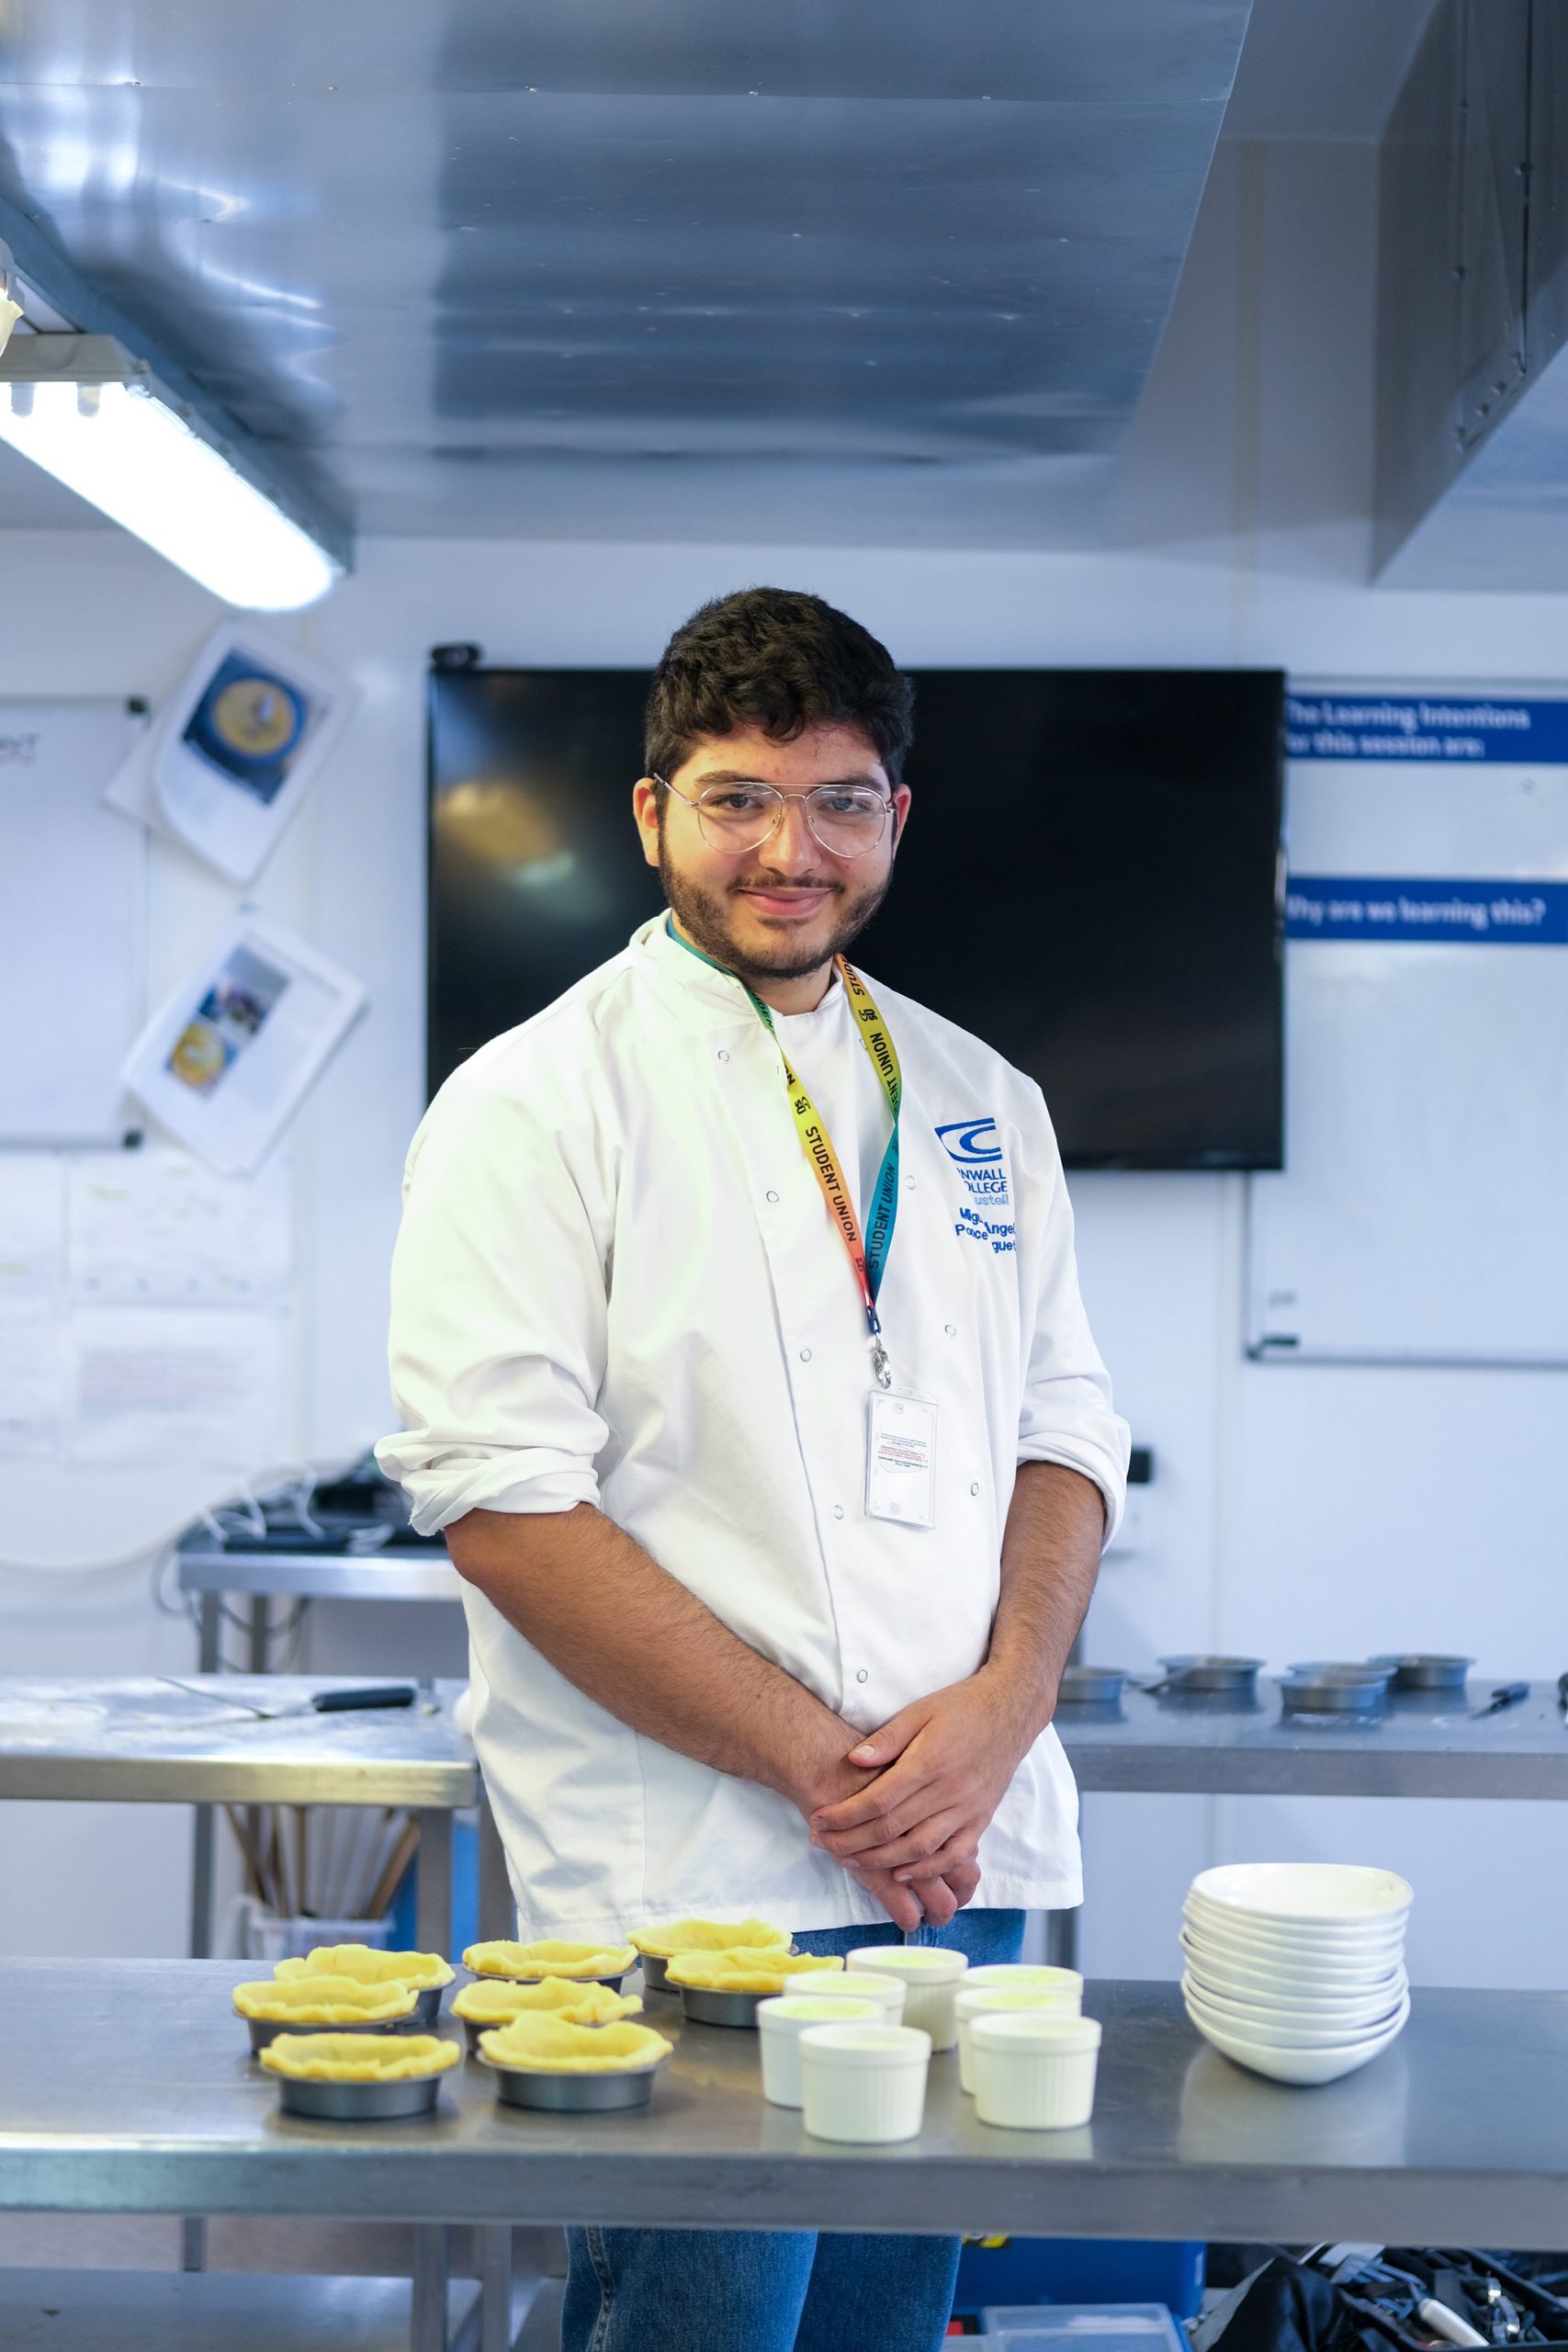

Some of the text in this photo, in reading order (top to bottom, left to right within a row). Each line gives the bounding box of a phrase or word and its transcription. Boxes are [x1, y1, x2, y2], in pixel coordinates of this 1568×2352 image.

[1321, 700, 1417, 734] Learning
[1418, 702, 1531, 729] Intentions
[1286, 733, 1310, 753] or
[1313, 729, 1357, 754] this
[1359, 734, 1441, 756] session
[1328, 900, 1363, 922] are
[1365, 900, 1397, 922] we
[1397, 895, 1489, 931] learning
[1490, 897, 1547, 925] this?
[870, 1032, 894, 1077] UNION
[806, 1125, 857, 1242] STUDENT UNION
[956, 1168, 1007, 1181] NWALL
[869, 1163, 896, 1269] STUDENT UNION
[975, 1193, 1010, 1205] ustell
